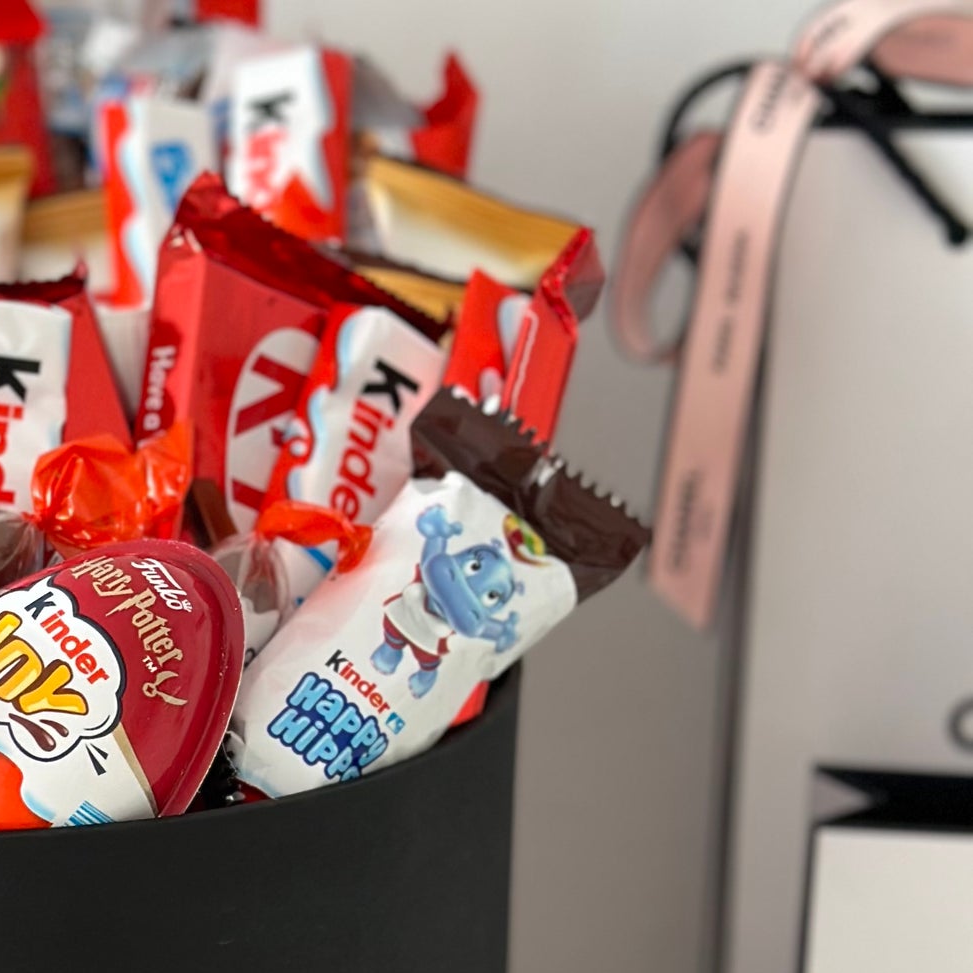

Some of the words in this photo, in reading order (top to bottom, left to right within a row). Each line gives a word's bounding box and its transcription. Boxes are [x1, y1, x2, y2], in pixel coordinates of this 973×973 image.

[144, 344, 177, 411] Have
[71, 556, 134, 597] Harry
[105, 587, 183, 667] Potter
[131, 557, 190, 611] Funko
